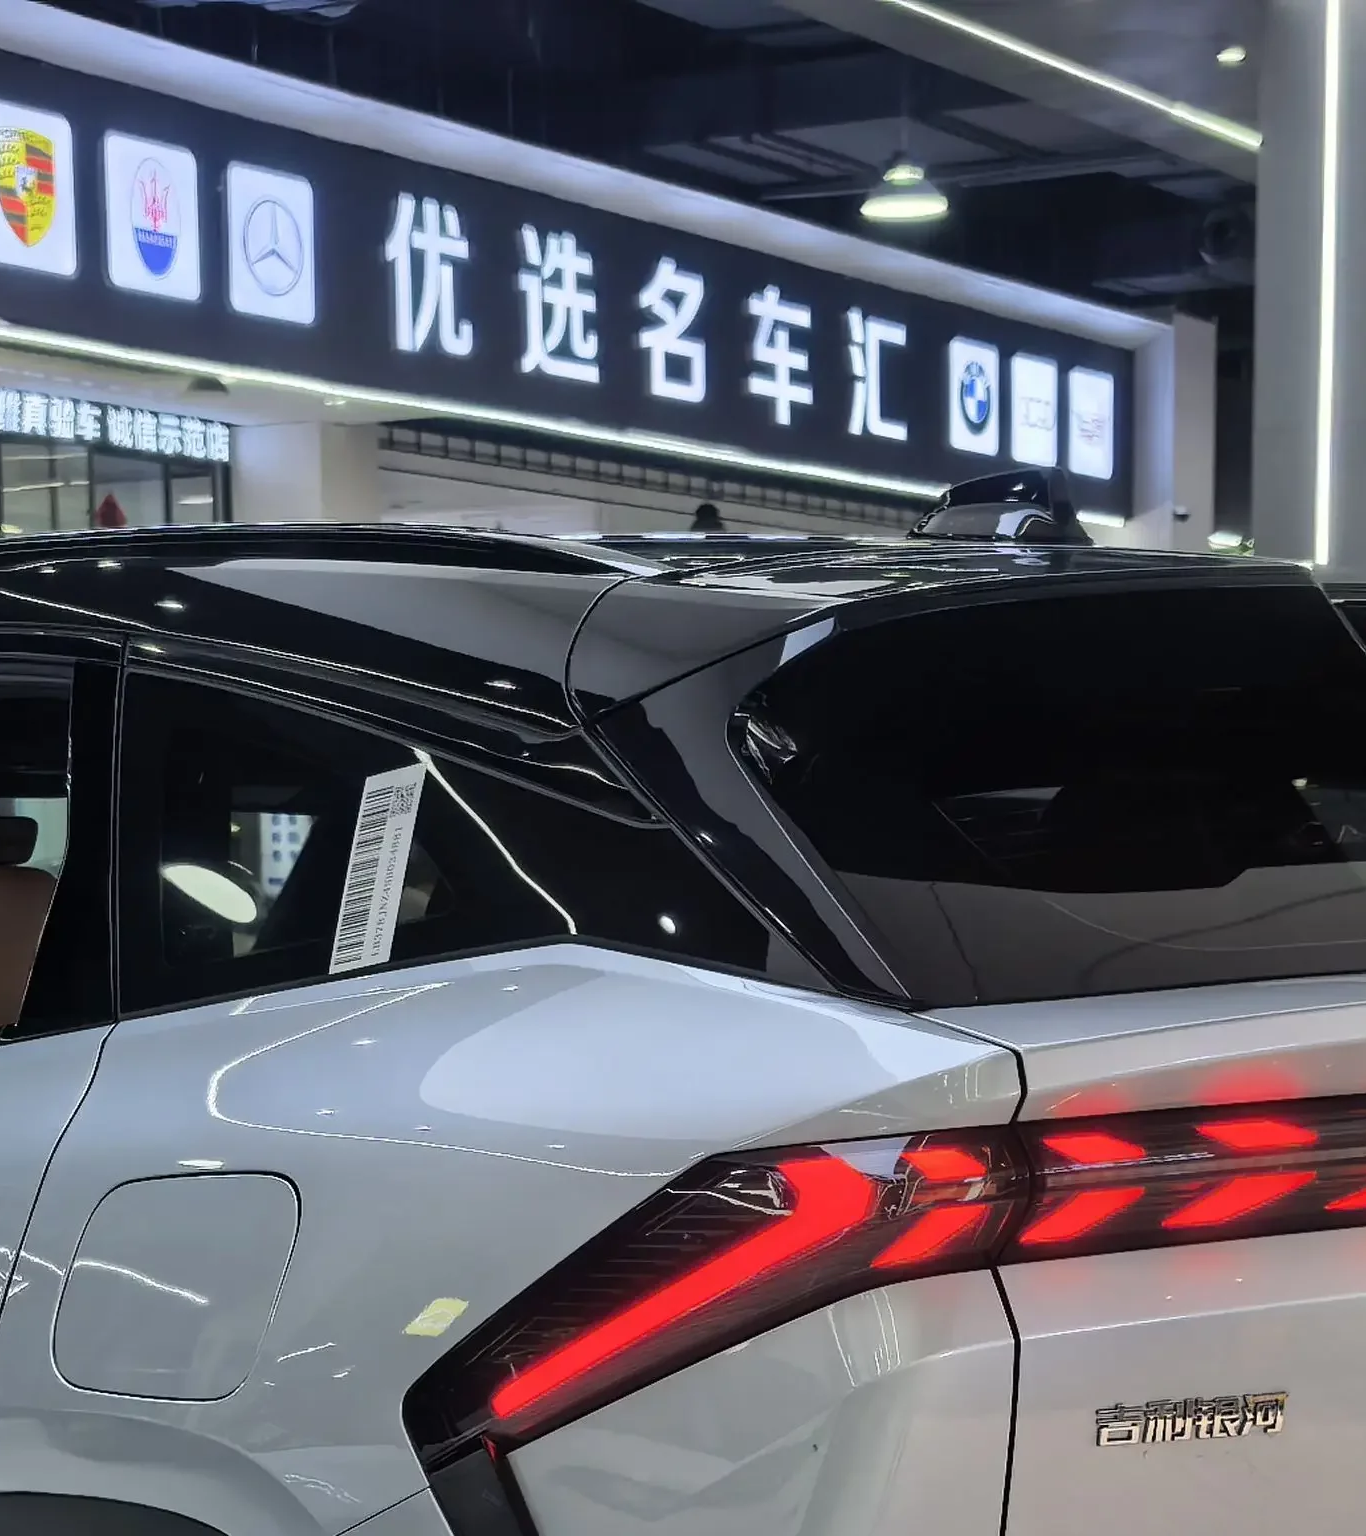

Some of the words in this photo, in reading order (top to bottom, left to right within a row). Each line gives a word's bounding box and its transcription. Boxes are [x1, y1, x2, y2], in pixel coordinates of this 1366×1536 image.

[384, 191, 908, 442] 优选名车汇
[1095, 1391, 1289, 1446] 吉利银河
